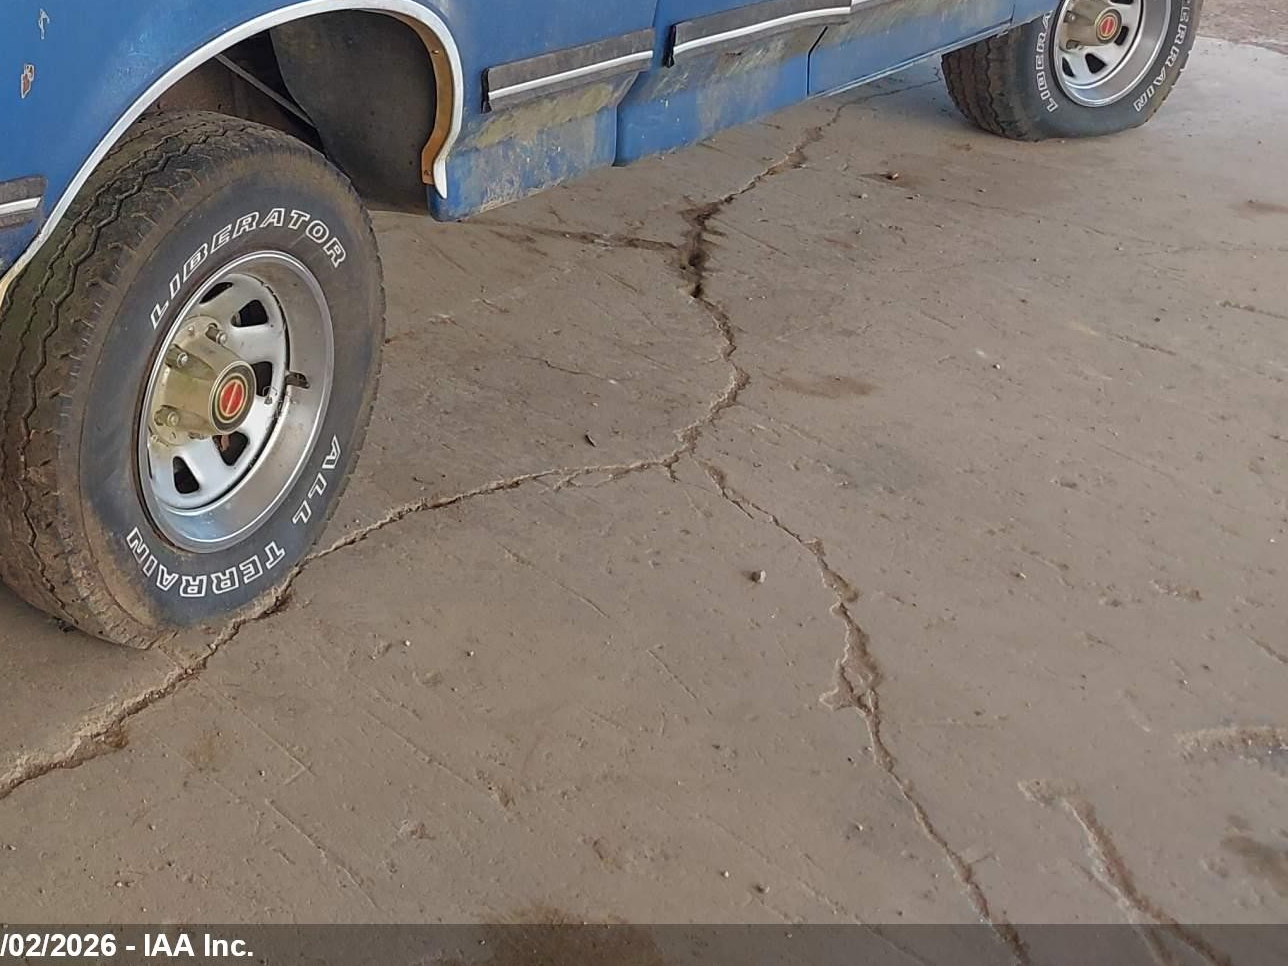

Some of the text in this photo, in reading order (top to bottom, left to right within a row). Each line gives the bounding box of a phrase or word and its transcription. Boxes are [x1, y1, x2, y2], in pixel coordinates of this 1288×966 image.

[149, 207, 347, 330] LIBERATOR
[126, 435, 341, 598] ALL TERRAIN
